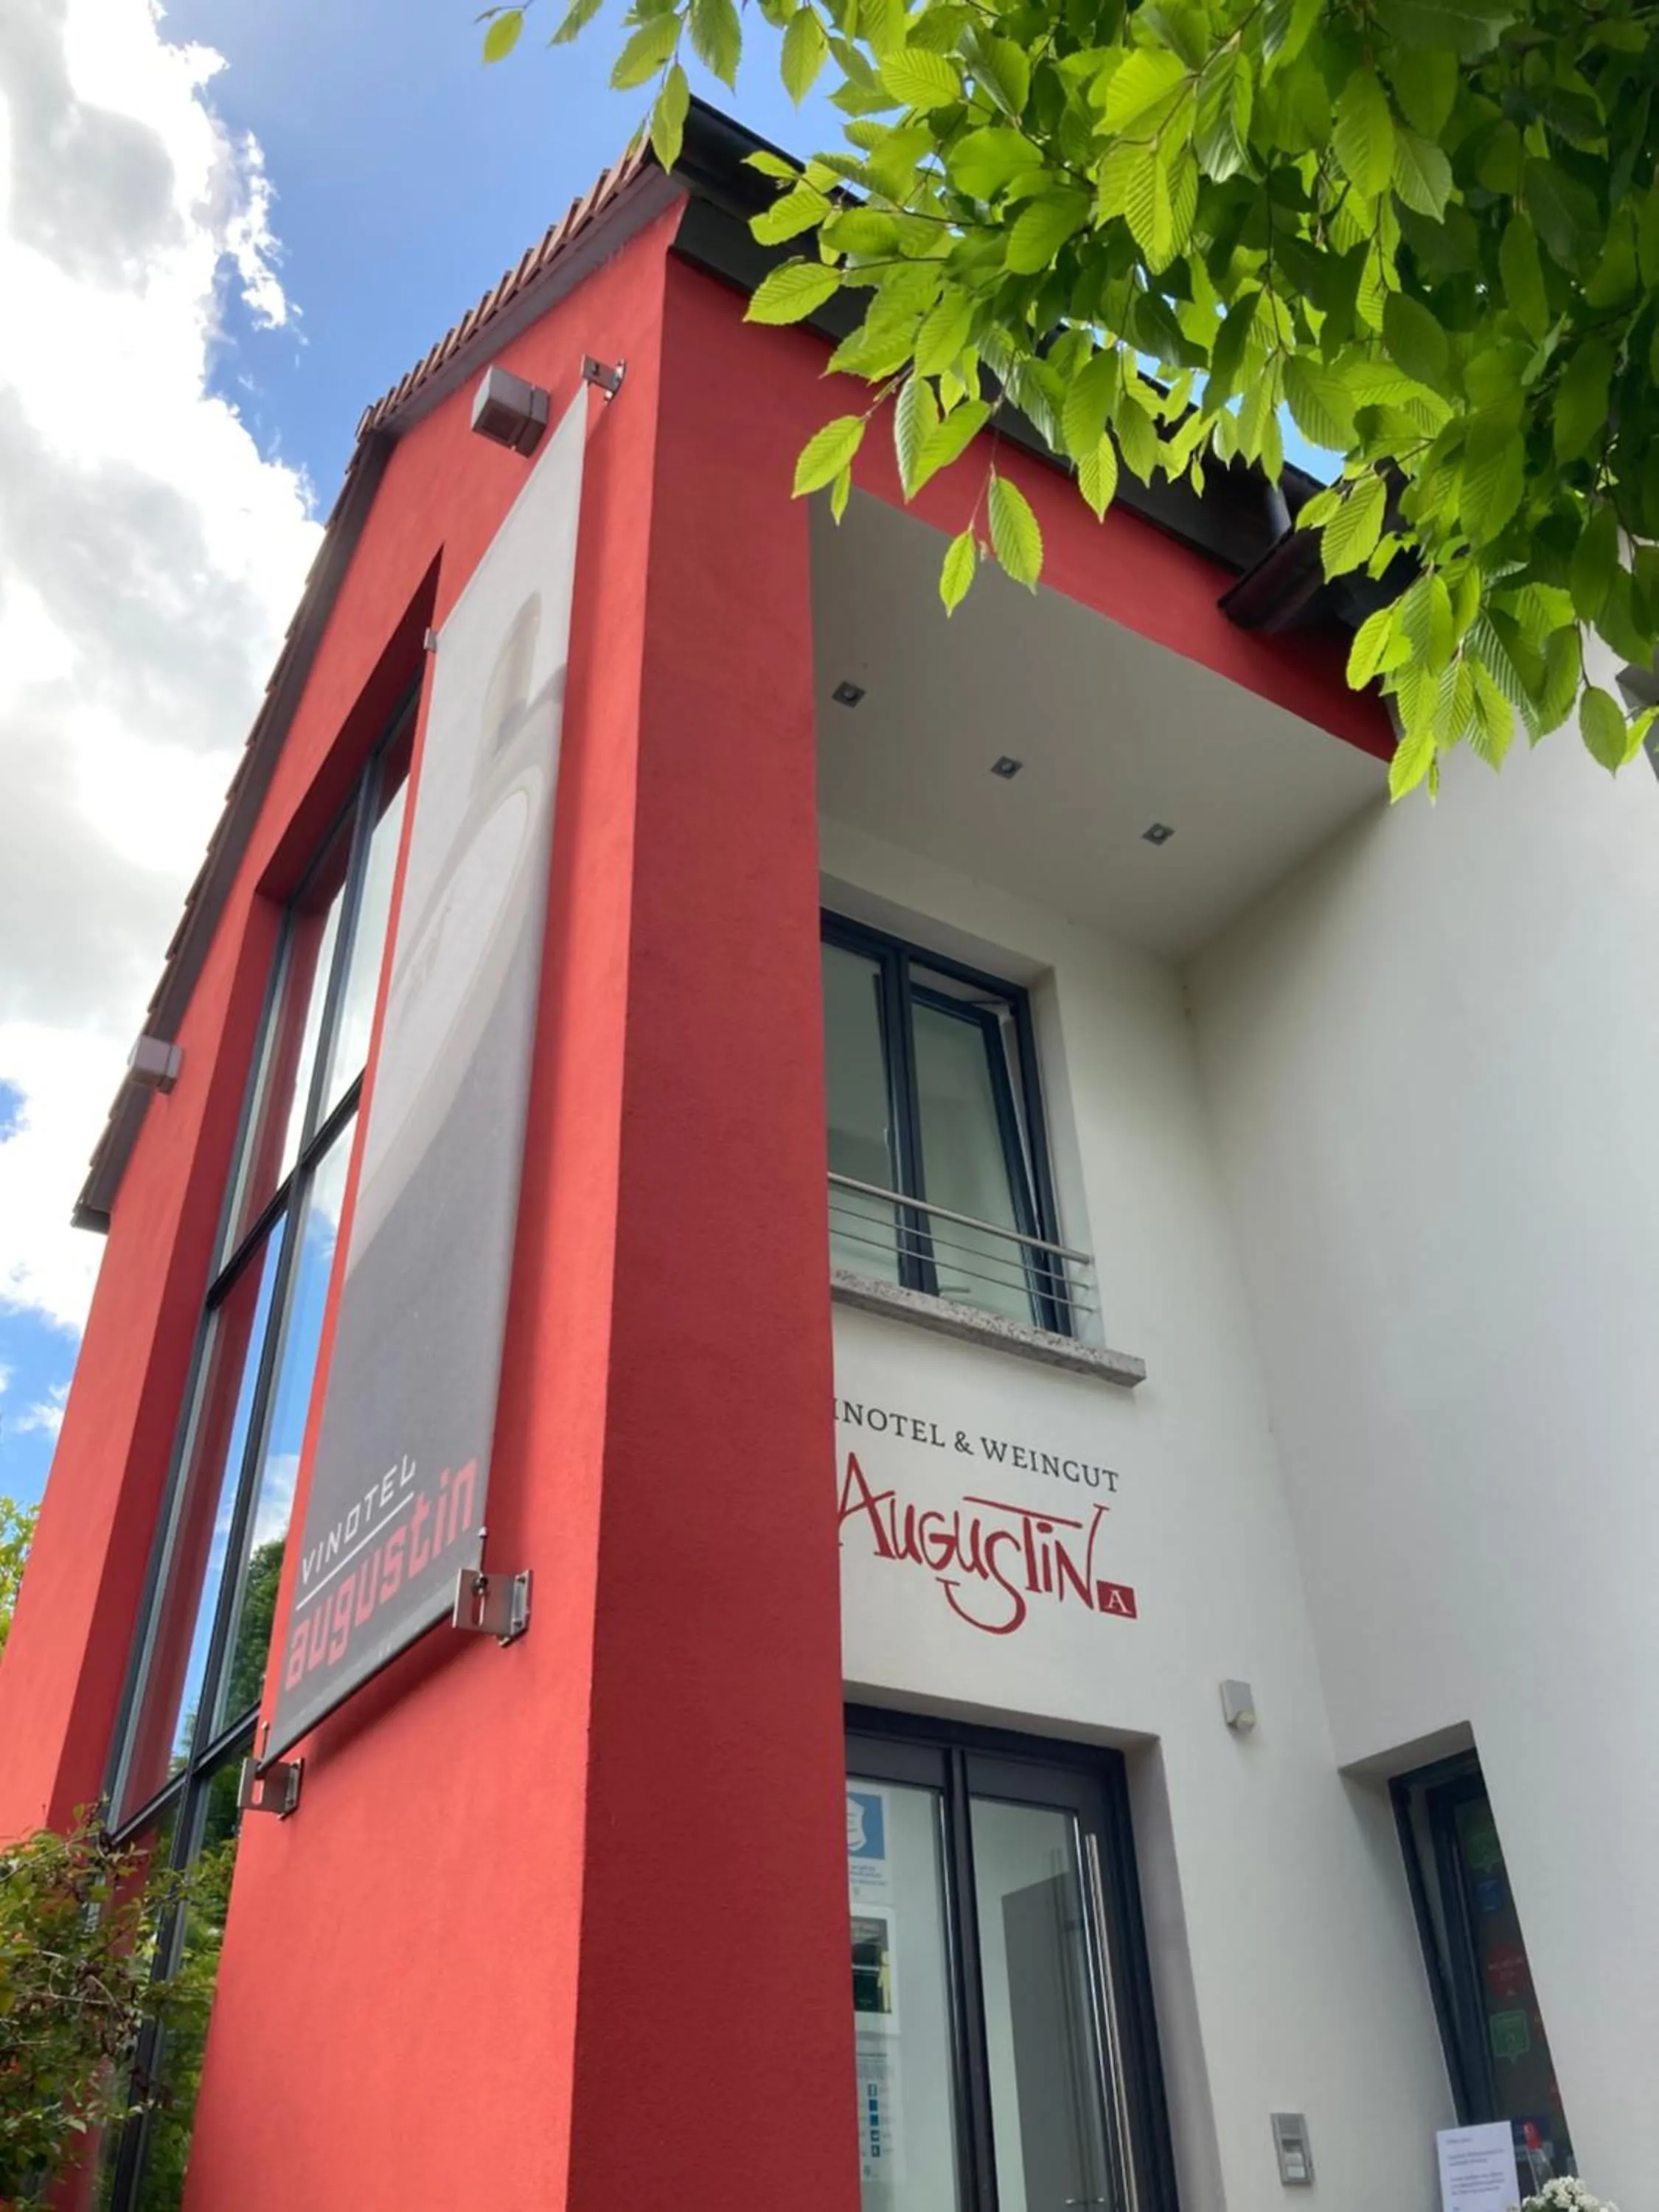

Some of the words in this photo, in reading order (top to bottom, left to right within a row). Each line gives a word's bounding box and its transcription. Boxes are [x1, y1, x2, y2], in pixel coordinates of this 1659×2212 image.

[954, 1430, 975, 1455] &
[979, 1437, 1119, 1492] WEINGUT
[302, 1454, 416, 1585] VINOTEL
